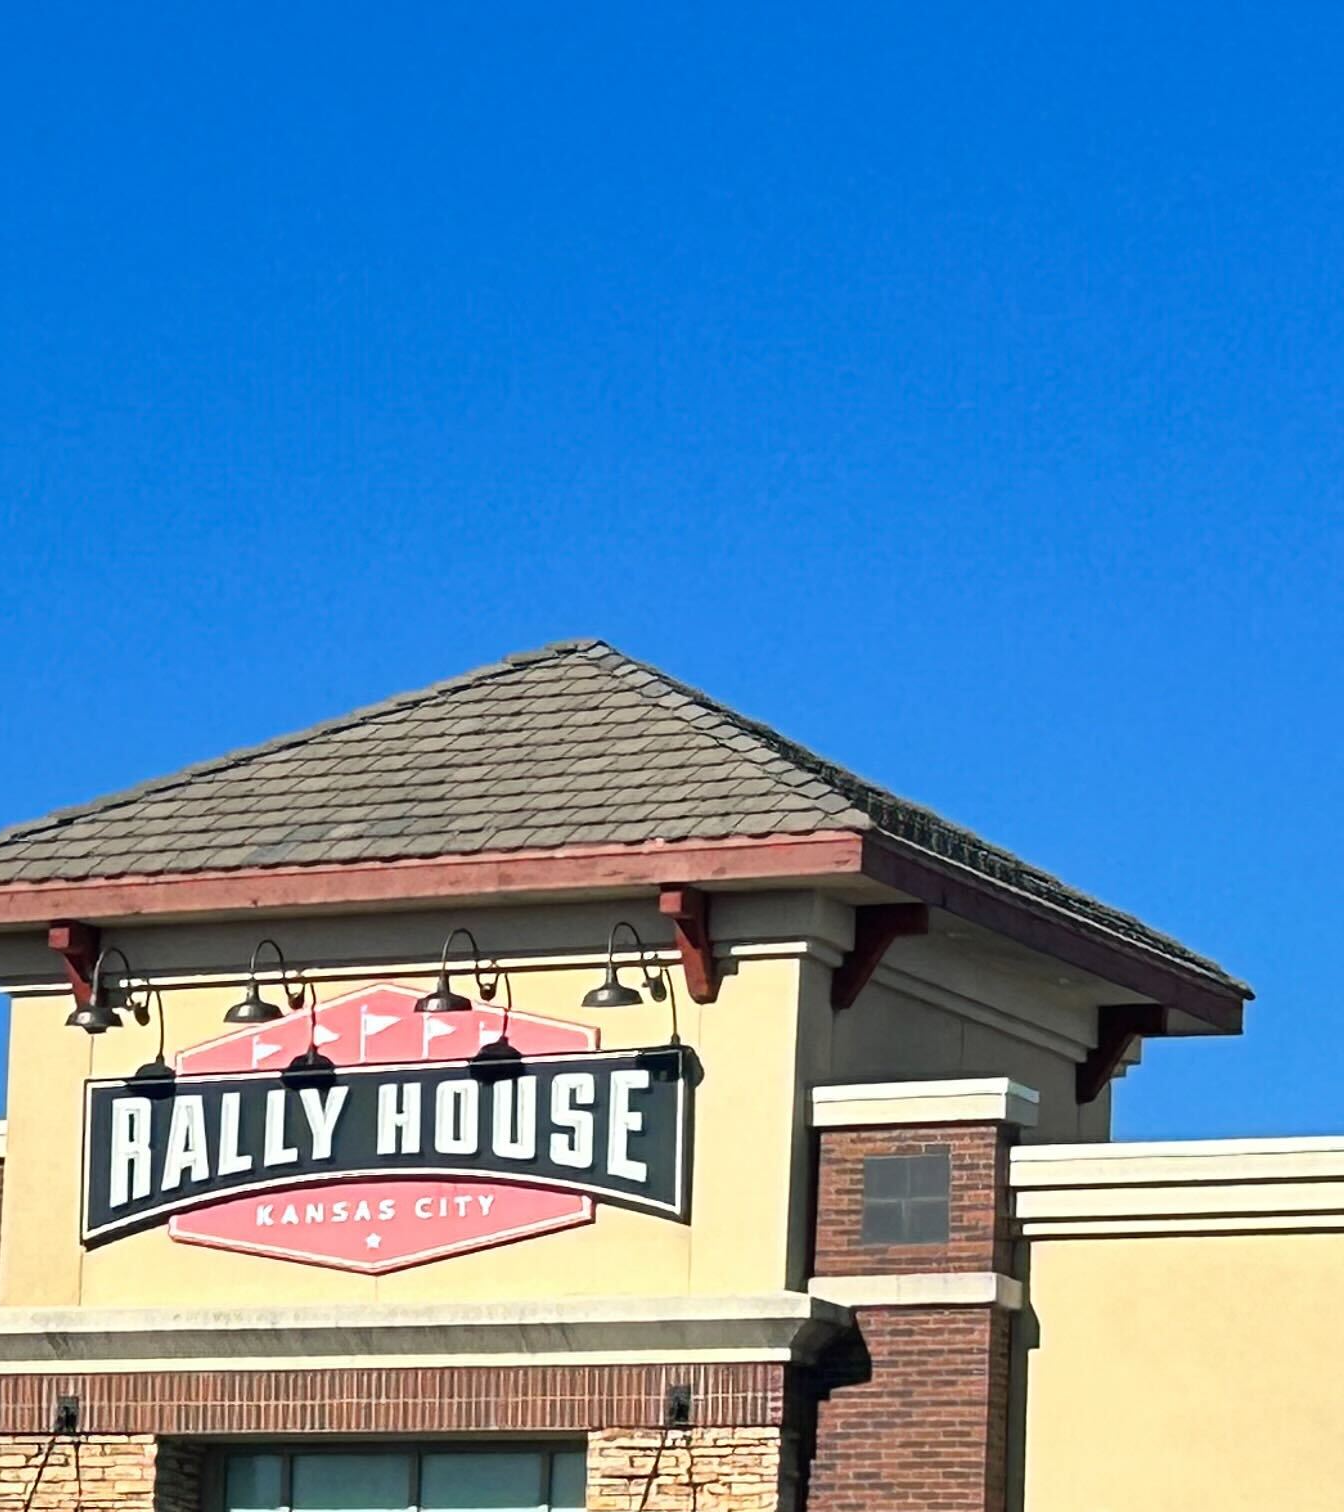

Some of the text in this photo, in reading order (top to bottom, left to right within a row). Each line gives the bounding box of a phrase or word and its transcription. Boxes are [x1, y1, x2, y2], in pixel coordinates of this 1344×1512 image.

[109, 1070, 650, 1208] RALLY HOUSE
[255, 1194, 496, 1226] KANSAS CITY
